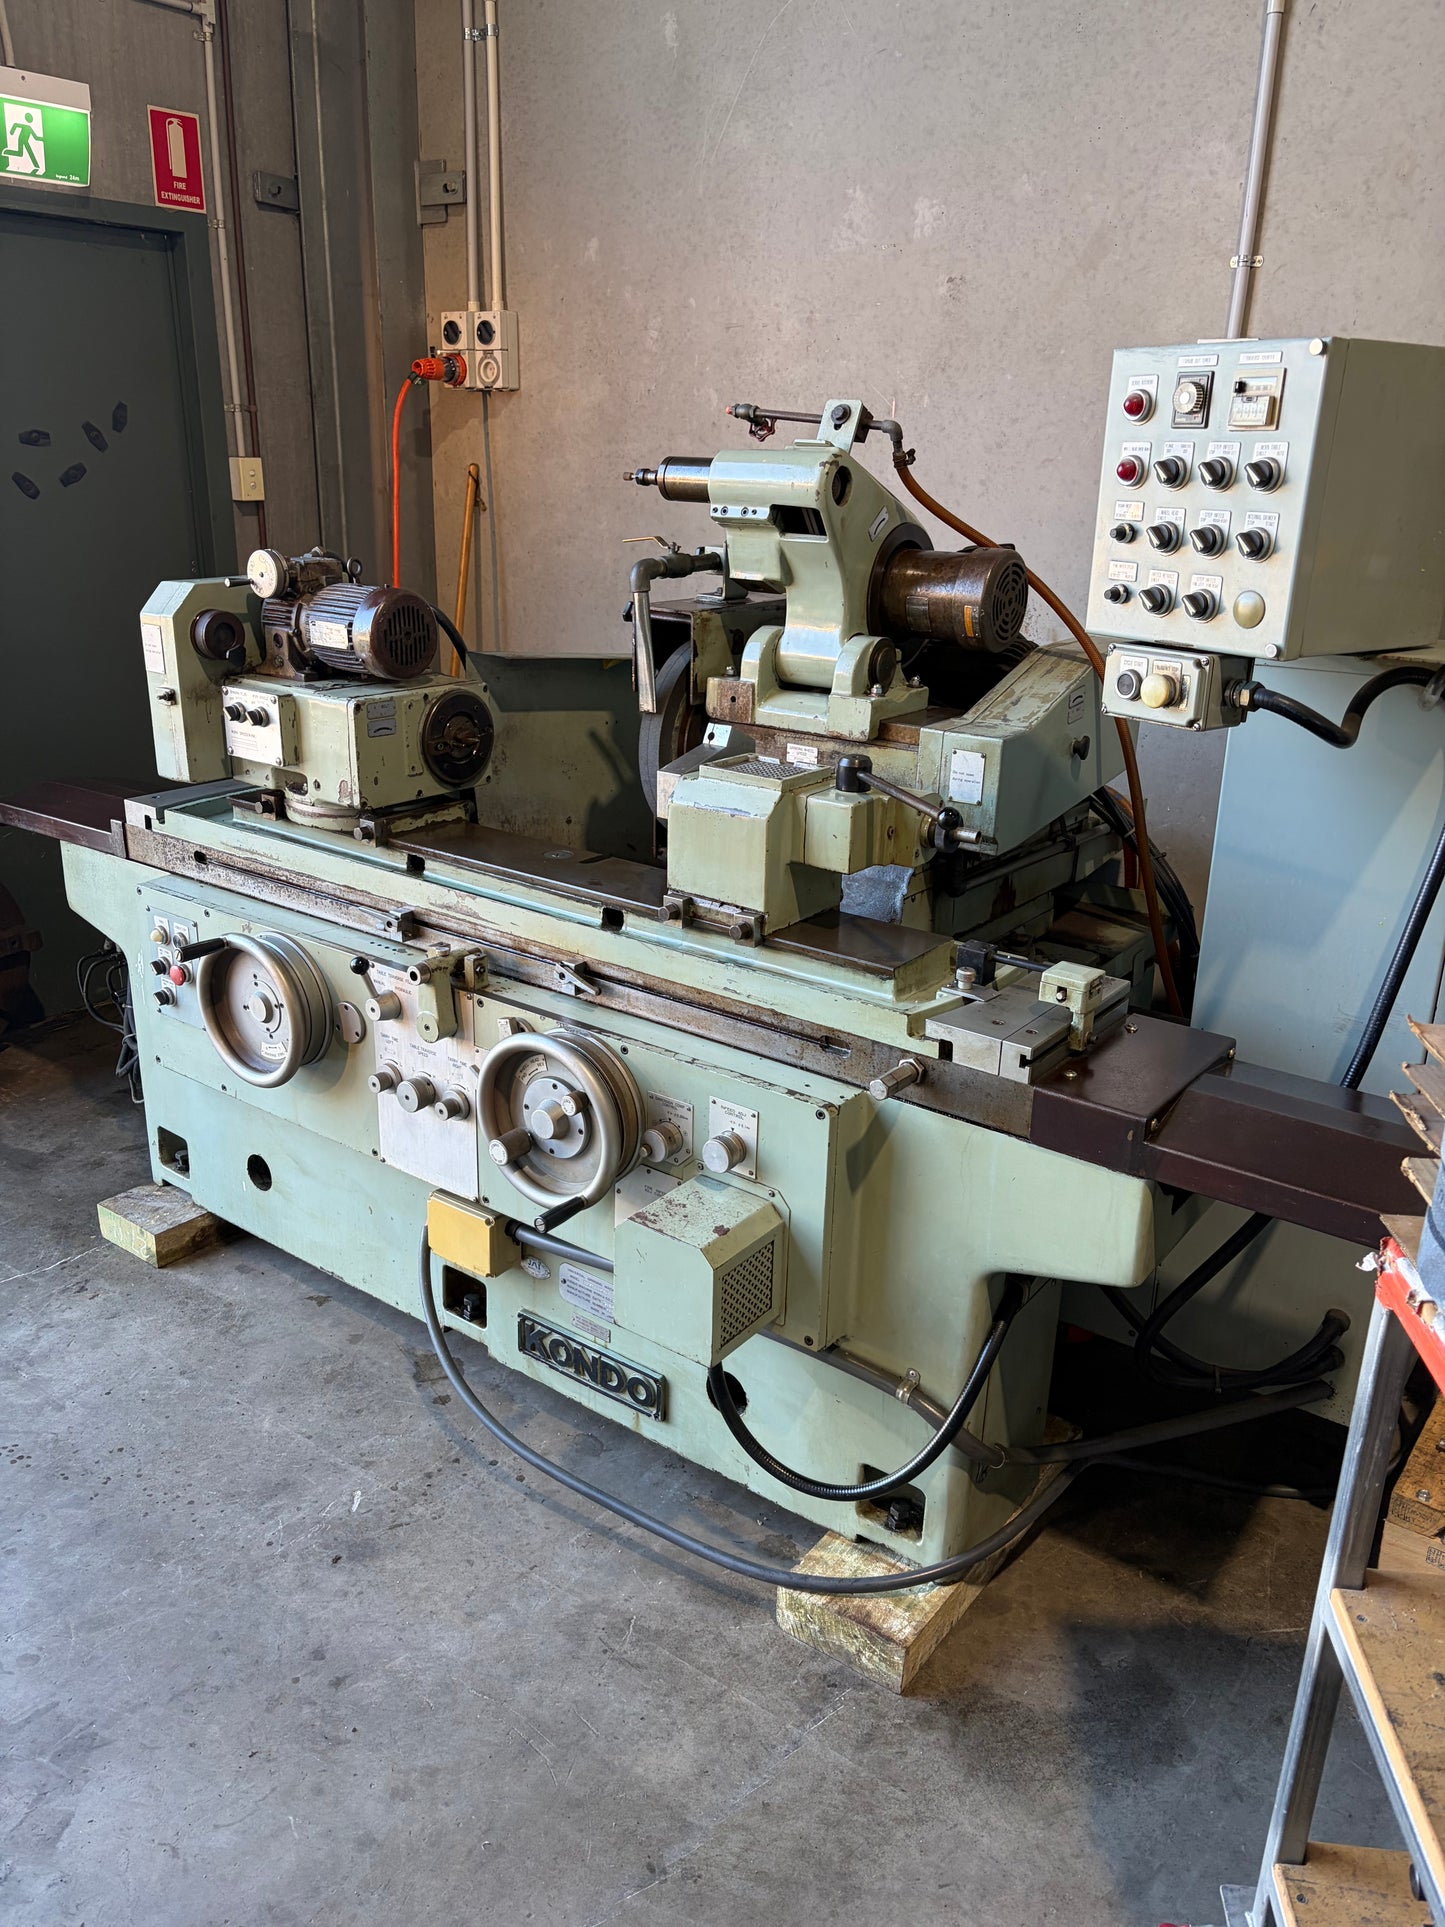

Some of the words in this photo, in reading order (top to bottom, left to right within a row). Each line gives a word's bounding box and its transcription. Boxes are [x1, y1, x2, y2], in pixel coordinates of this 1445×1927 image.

[173, 181, 187, 191] FIRE
[160, 191, 201, 205] EXTINGUISHER
[524, 1321, 656, 1407] KONDO
